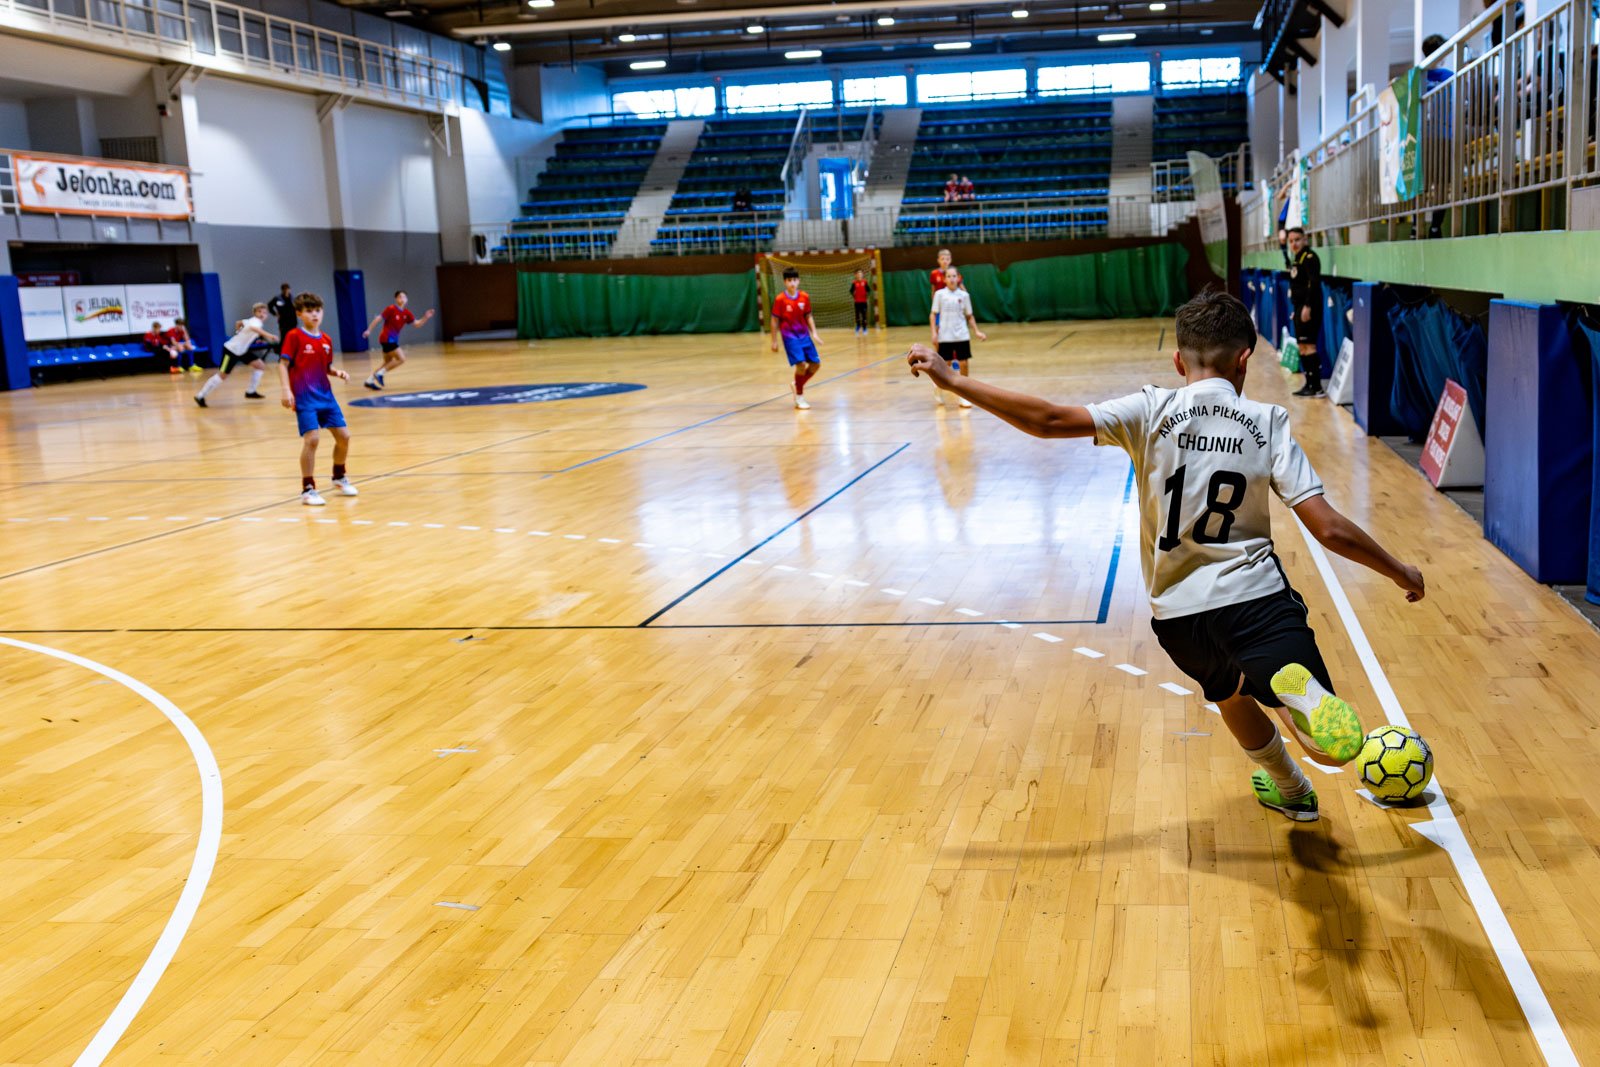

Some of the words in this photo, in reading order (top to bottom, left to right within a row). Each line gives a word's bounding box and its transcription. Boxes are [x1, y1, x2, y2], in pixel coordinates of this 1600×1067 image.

[56, 167, 176, 200] Jelonka.com
[88, 297, 121, 311] JELENIA
[1158, 405, 1209, 439] AKADEMIA
[1212, 405, 1268, 449] PIŁKARSKA
[1177, 432, 1244, 454] CHOJNIK
[1158, 463, 1248, 552] 18
